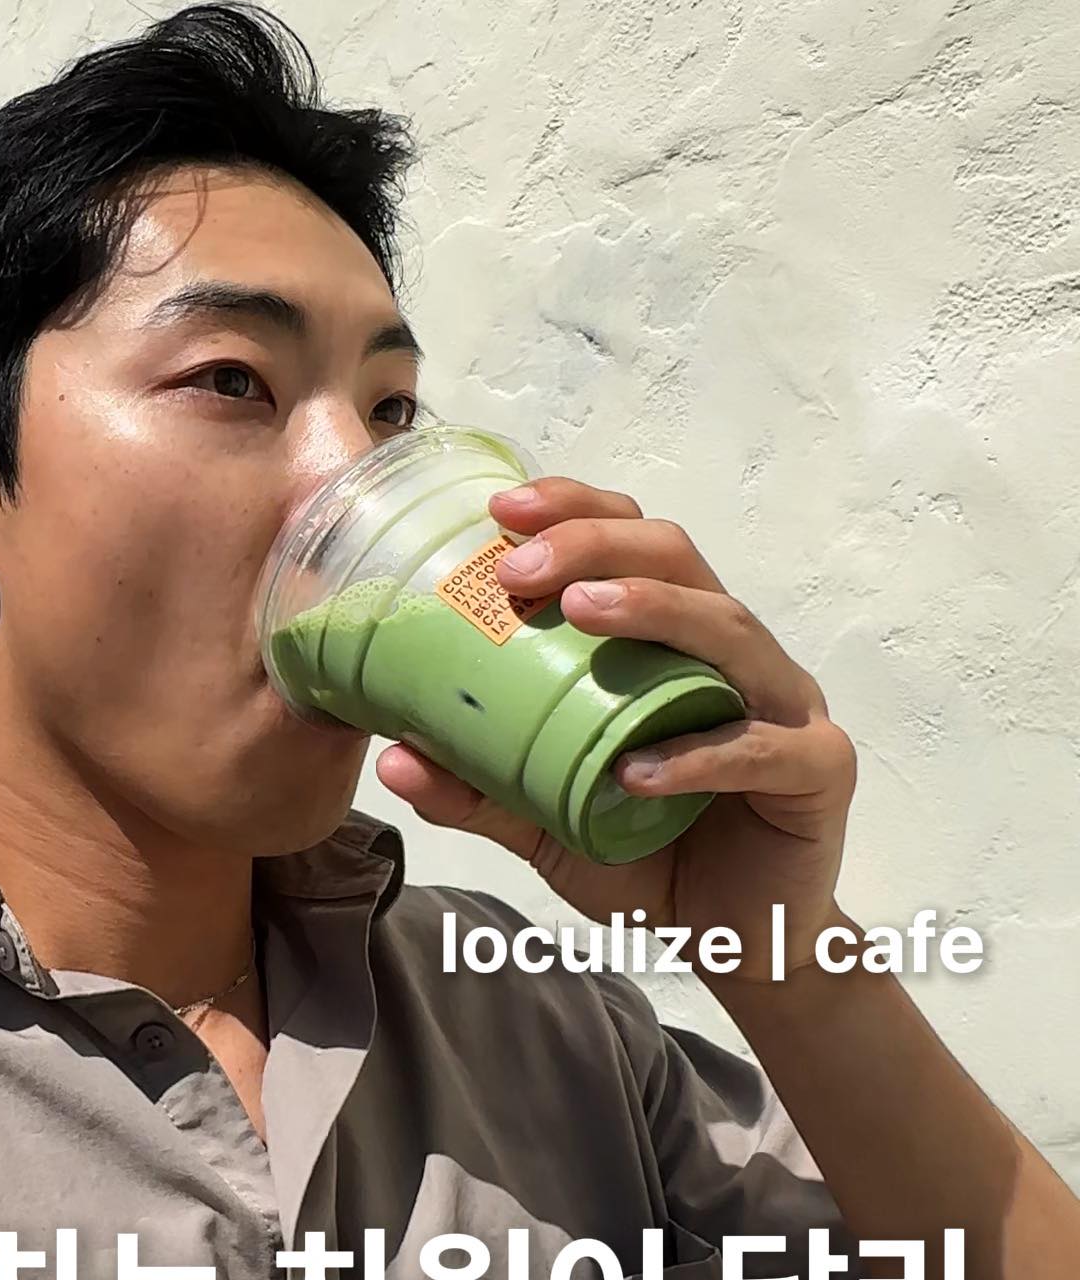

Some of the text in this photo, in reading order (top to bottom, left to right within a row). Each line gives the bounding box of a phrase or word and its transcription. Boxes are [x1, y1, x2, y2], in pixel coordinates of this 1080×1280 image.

[452, 558, 501, 602] ITY GO
[461, 587, 487, 610] 710
[492, 620, 510, 635] IA
